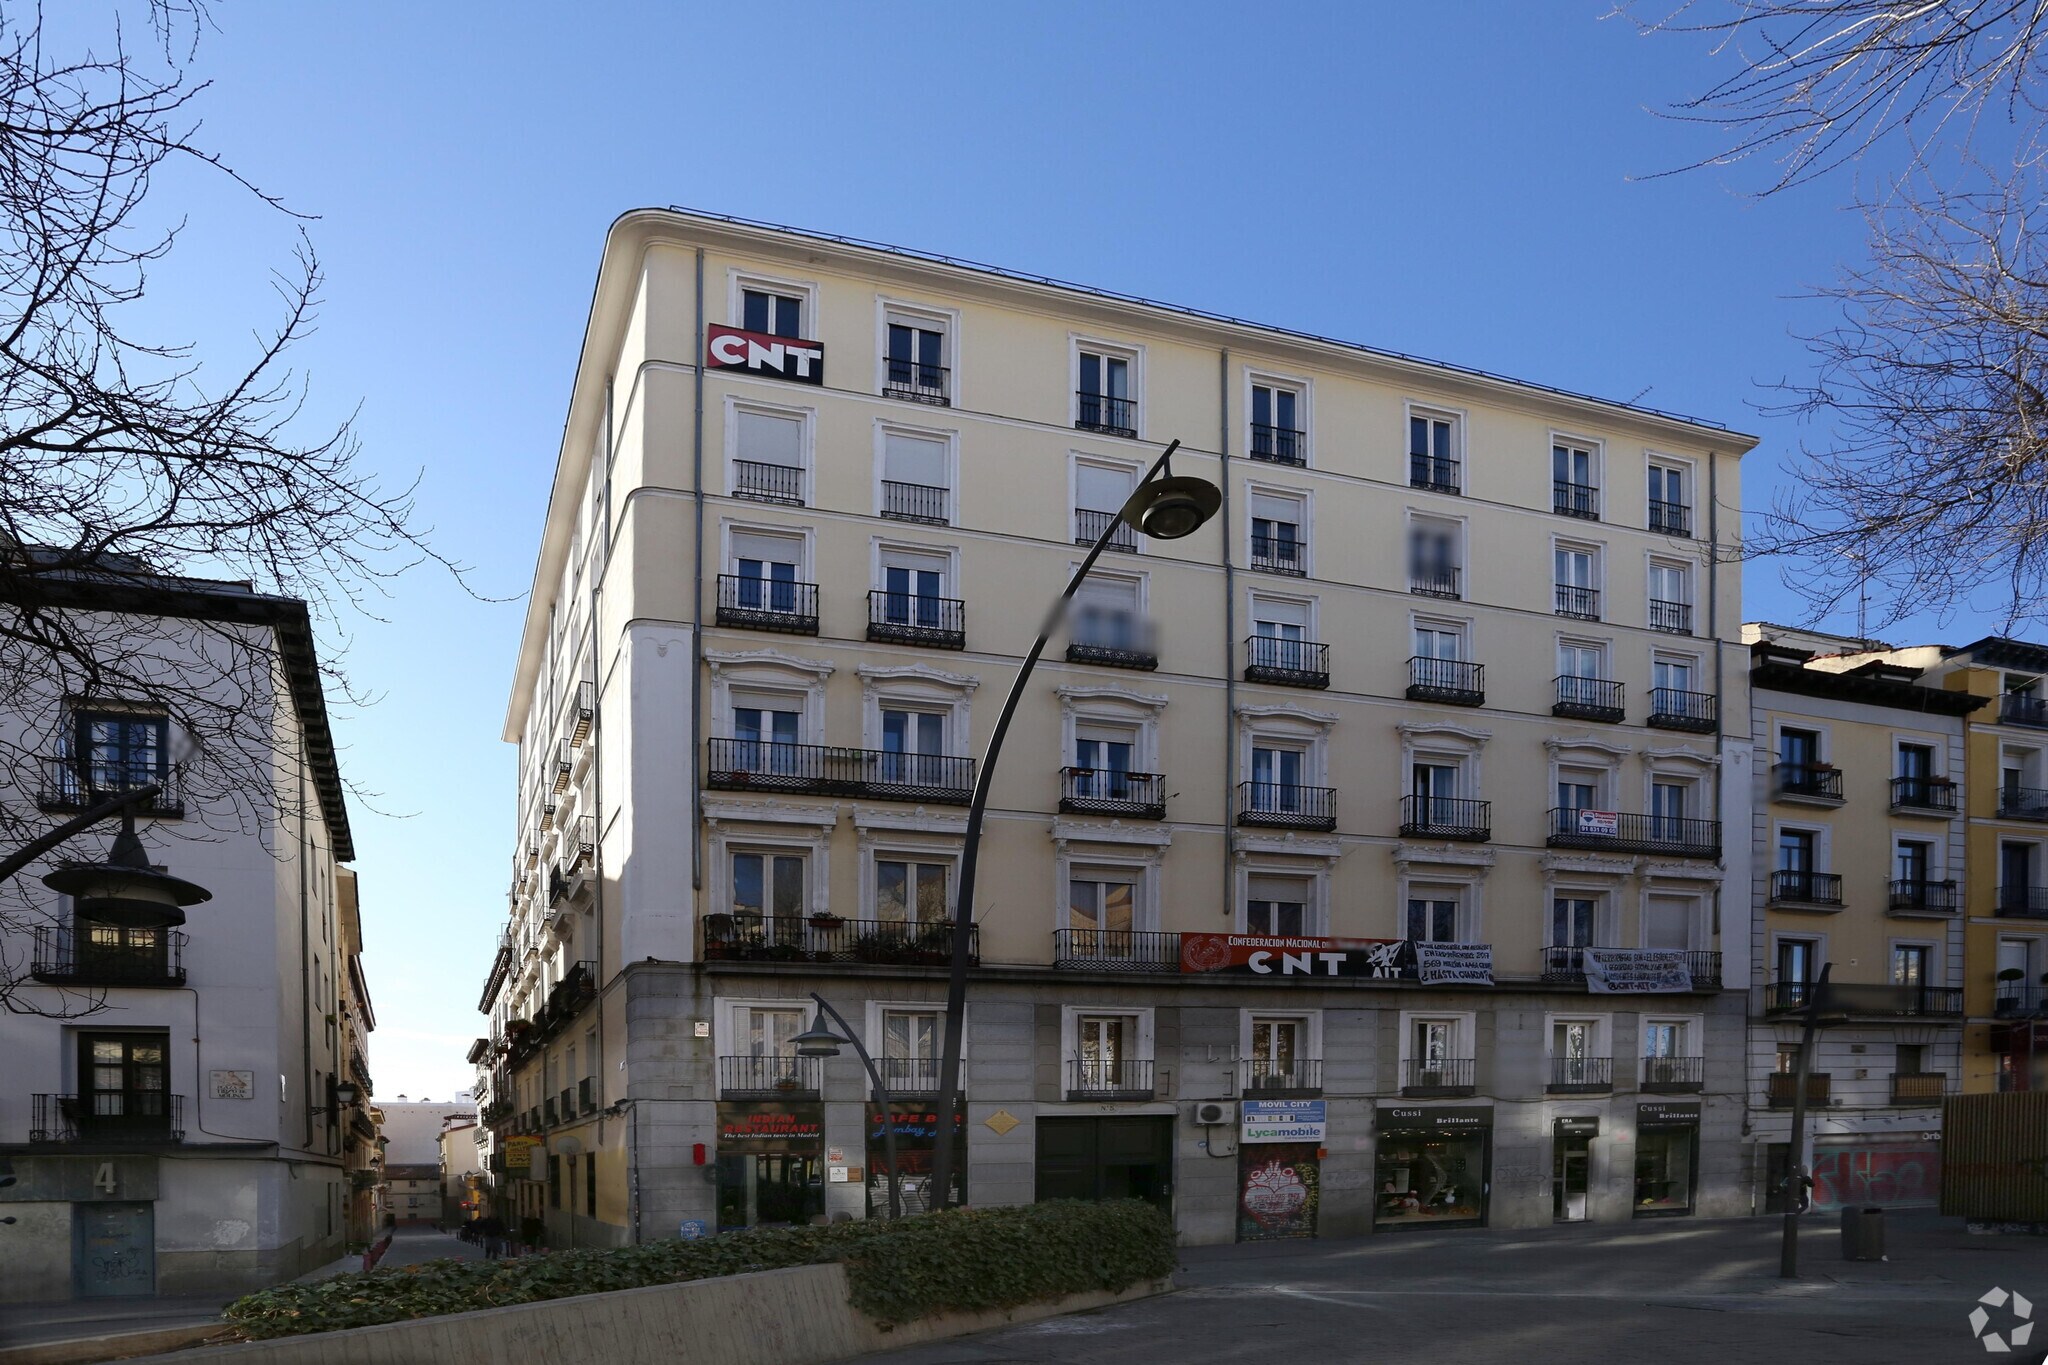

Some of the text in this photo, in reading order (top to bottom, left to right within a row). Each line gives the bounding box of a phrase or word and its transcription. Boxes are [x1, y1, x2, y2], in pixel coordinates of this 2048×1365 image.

[710, 335, 821, 377] CNT
[1228, 936, 1284, 947] CONFEDERACION
[1286, 937, 1321, 948] NACIONAL
[1248, 951, 1346, 976] CNT
[1372, 966, 1402, 979] AIT
[747, 1114, 796, 1123] INDIAN
[925, 1114, 961, 1123] BR
[1392, 1109, 1421, 1117] Cussi
[723, 1124, 818, 1133] RESTAURANT
[1247, 1127, 1320, 1138] Lycamobile
[94, 1162, 116, 1194] 4
